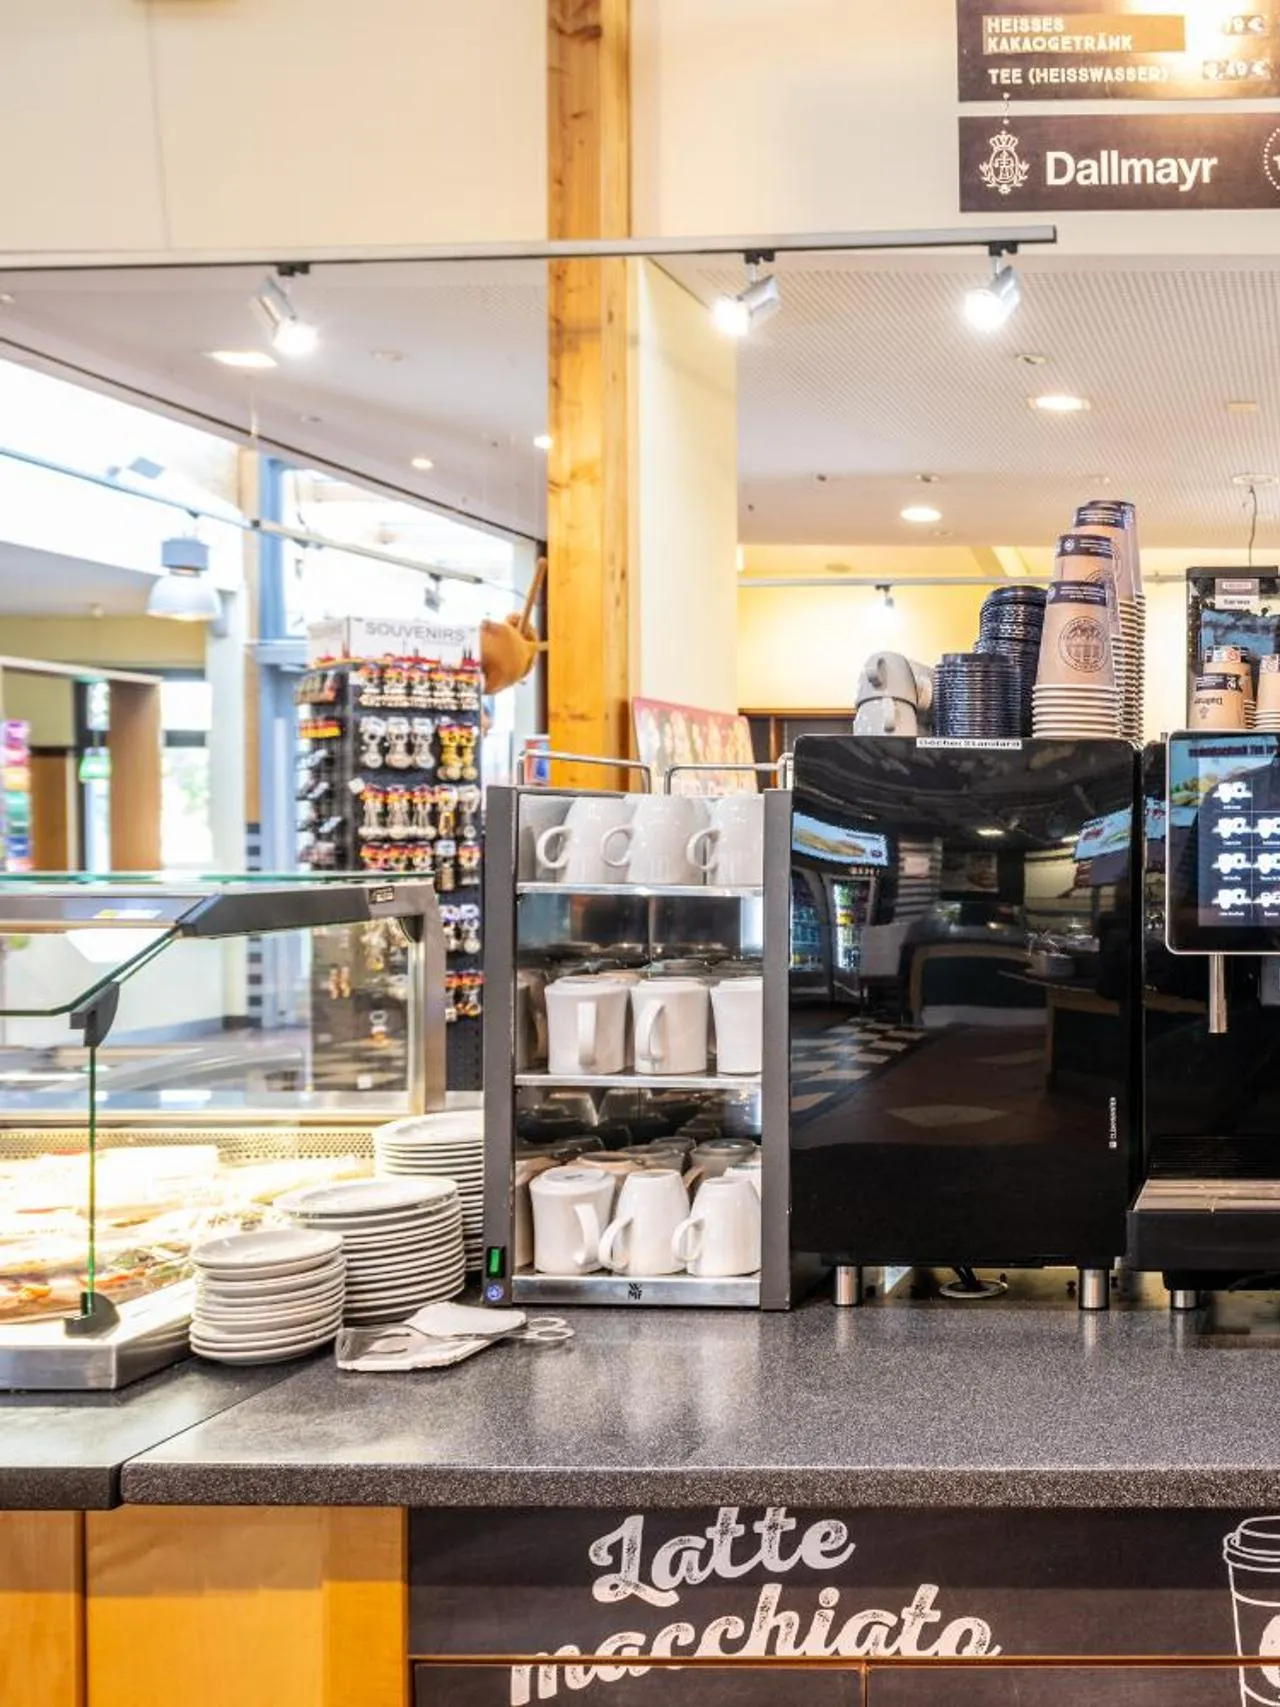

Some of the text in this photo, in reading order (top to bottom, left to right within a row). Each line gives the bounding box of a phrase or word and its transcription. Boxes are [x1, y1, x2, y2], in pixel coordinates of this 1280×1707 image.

[988, 16, 1065, 33] HEISSES
[988, 32, 1133, 52] KAKAOGETRÄNK
[988, 65, 1169, 86] TEE (HEISSWASSER)
[1045, 151, 1218, 191] Dallmayr
[365, 621, 465, 642] SOUVENIRS
[588, 1506, 856, 1607] Latte
[510, 1583, 1002, 1706] macchiato
